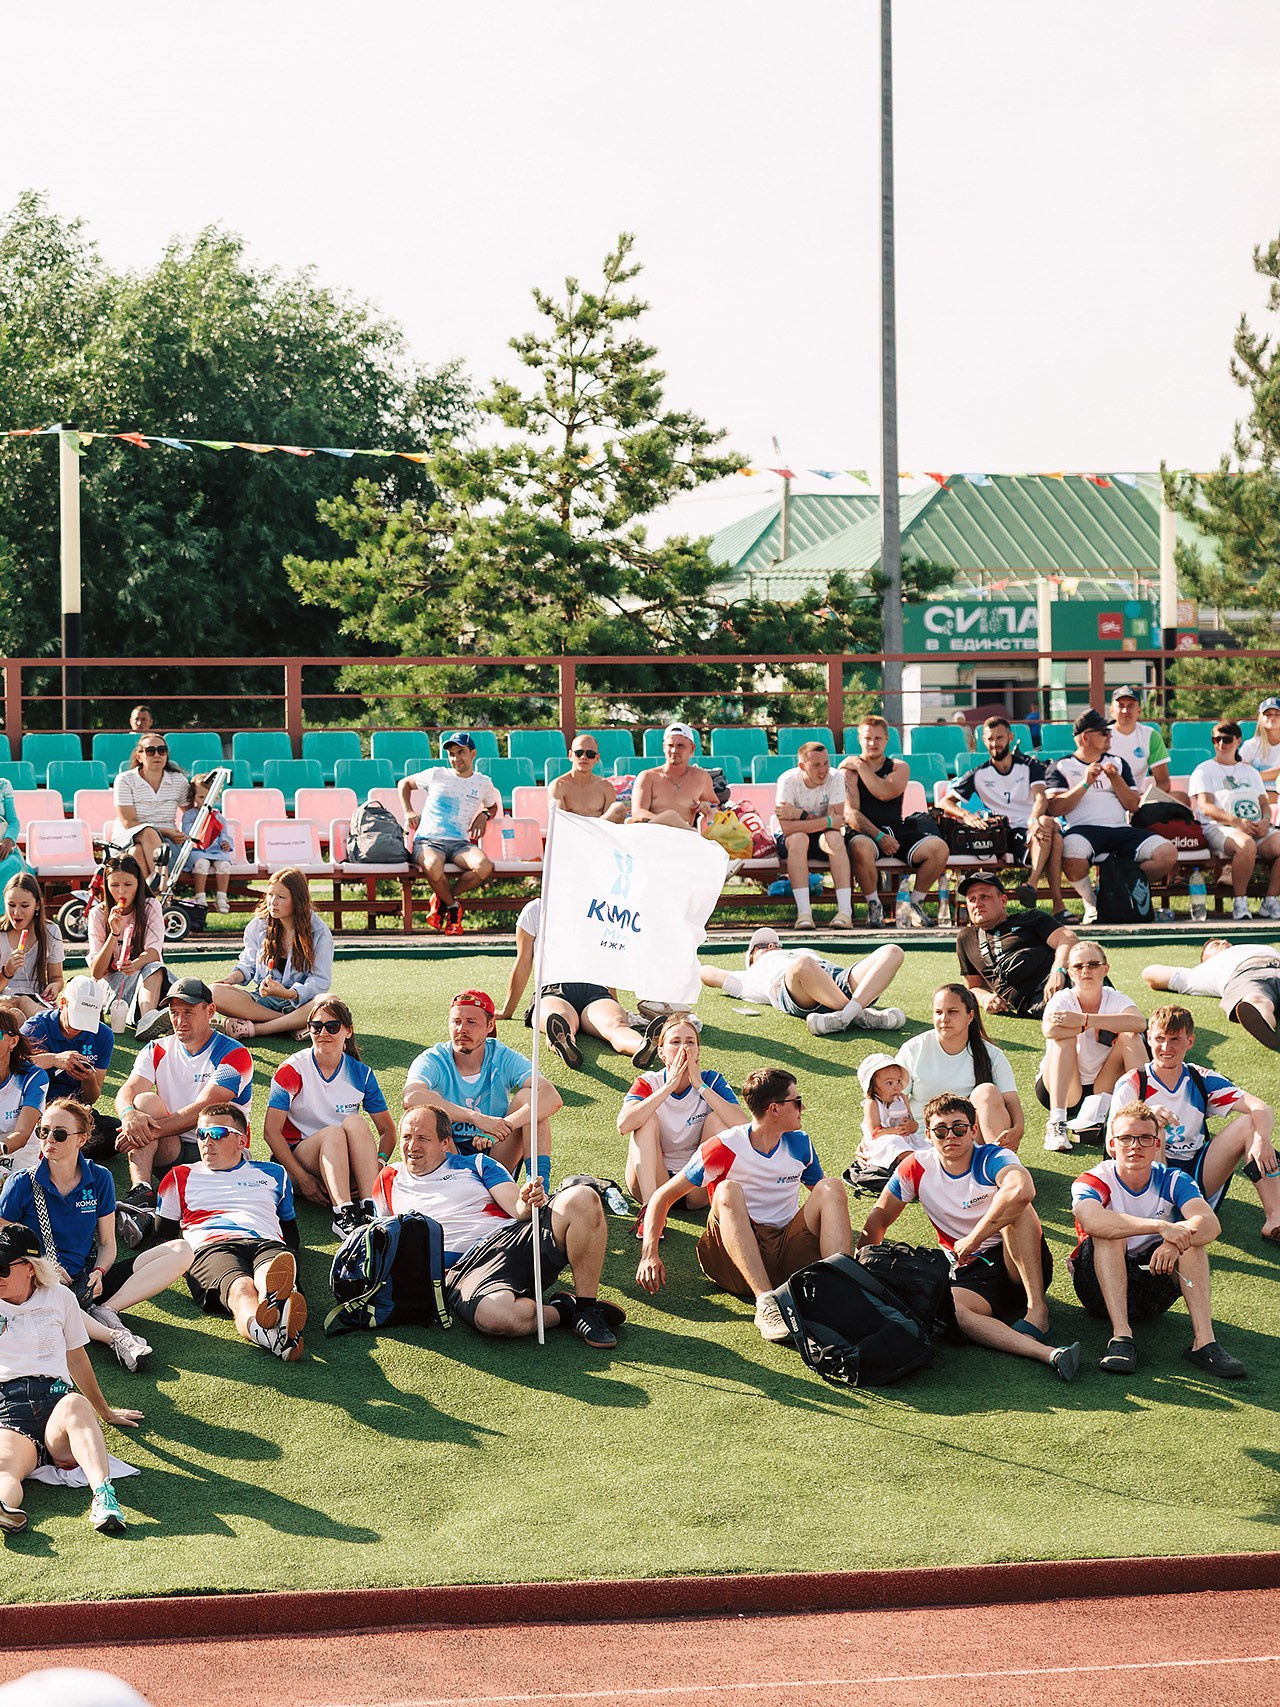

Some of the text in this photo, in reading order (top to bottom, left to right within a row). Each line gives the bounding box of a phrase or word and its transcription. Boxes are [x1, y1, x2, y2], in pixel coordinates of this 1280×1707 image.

[924, 605, 1039, 634] СИЛА
[926, 638, 1039, 651] В ЕДИНСТВ
[1004, 791, 1011, 804] 7
[1171, 836, 1199, 847] didas
